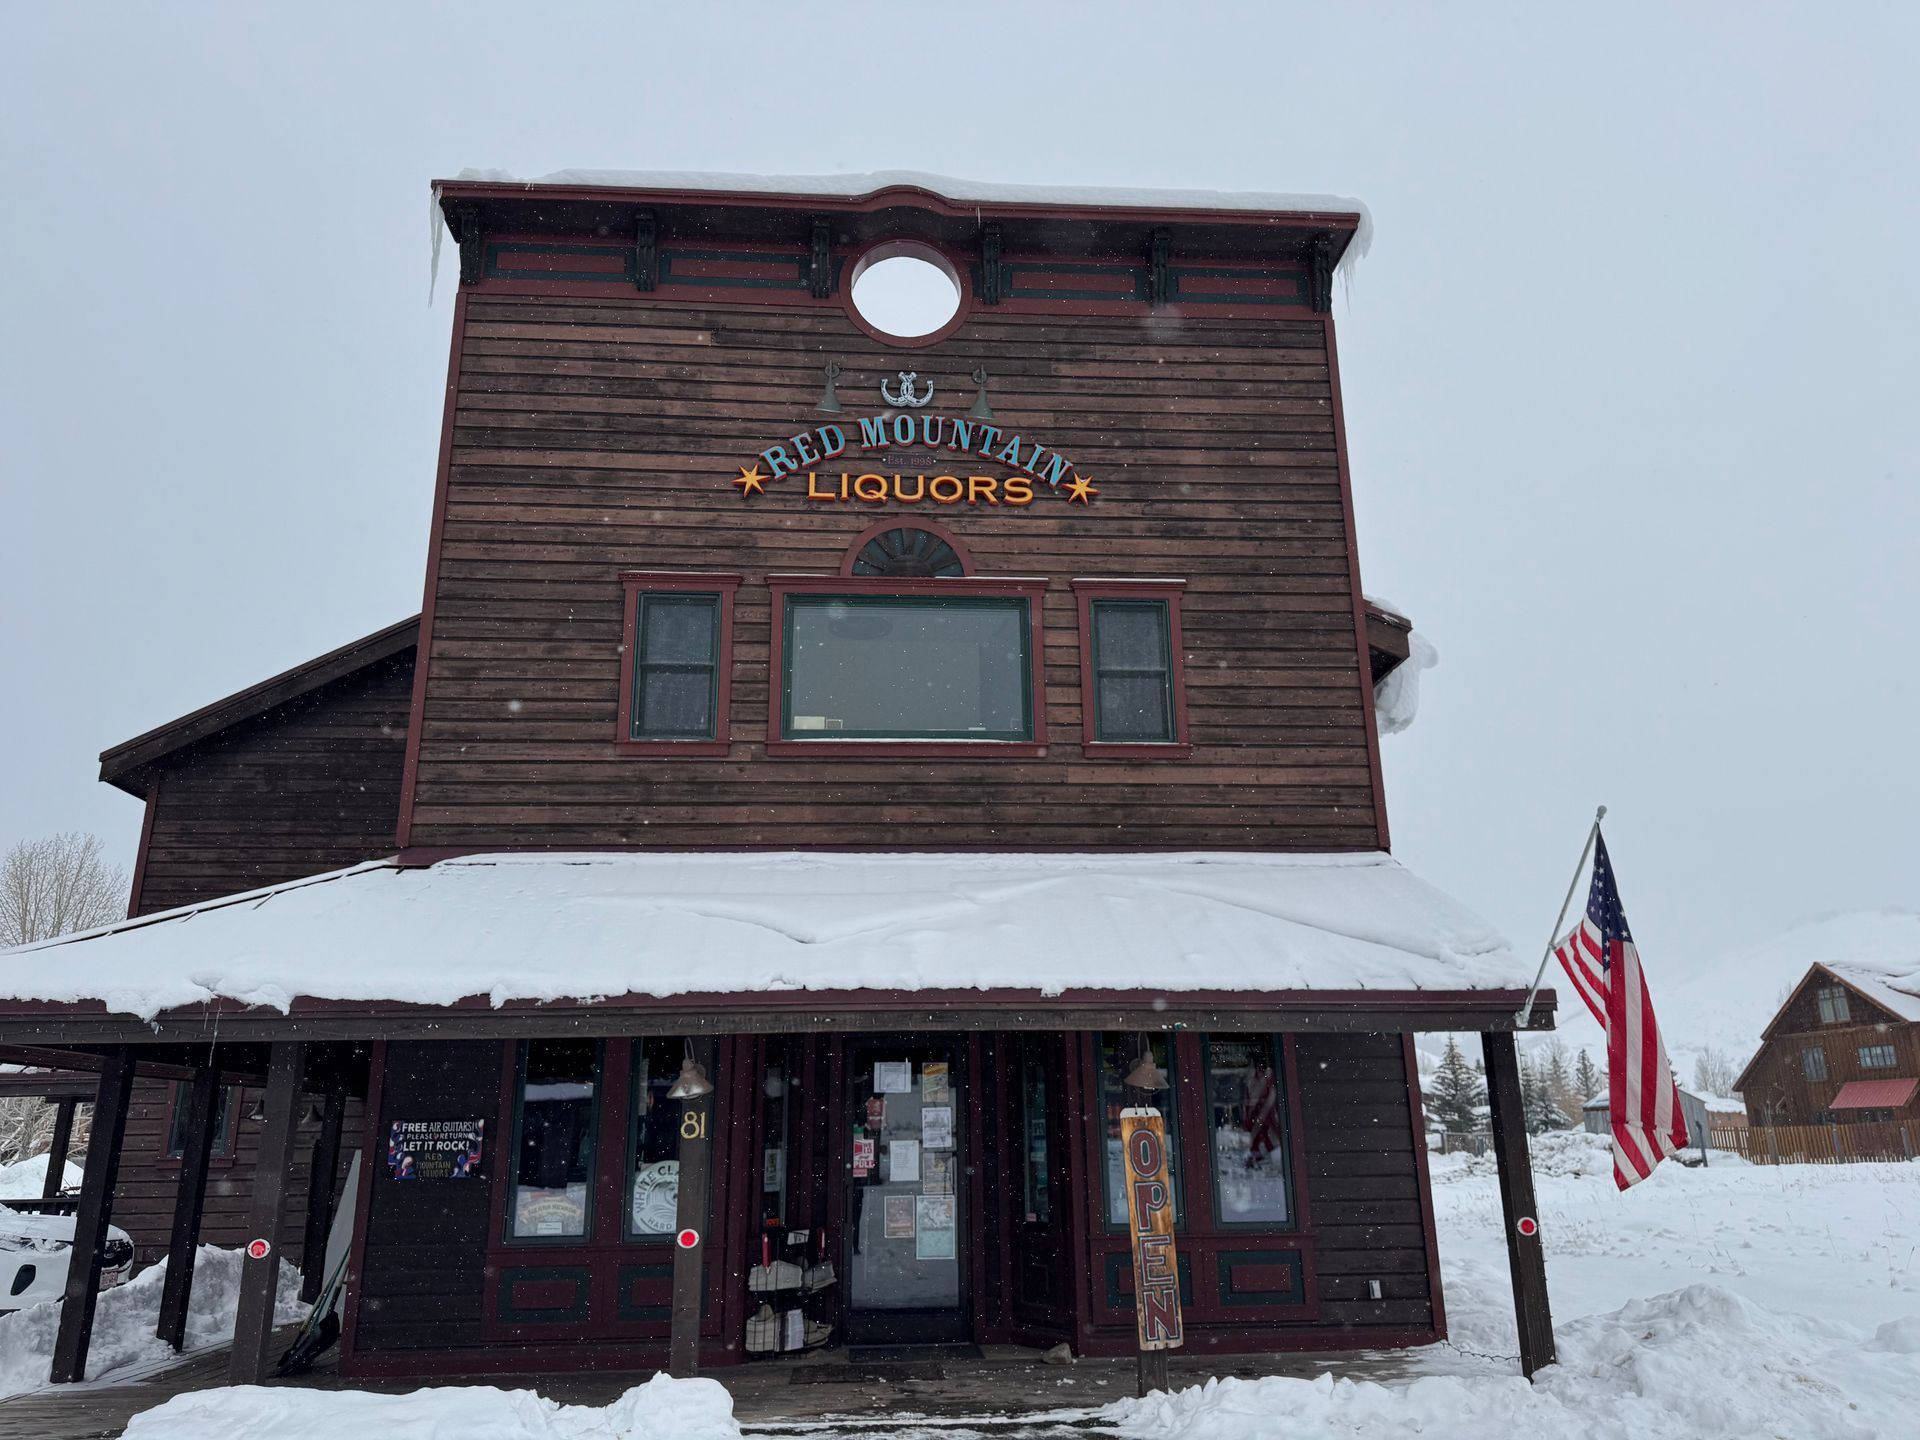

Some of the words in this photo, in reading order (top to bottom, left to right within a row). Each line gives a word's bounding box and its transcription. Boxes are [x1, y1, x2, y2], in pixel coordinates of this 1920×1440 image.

[760, 424, 846, 481] RED
[857, 414, 1074, 490] MOUNTAIN
[887, 455, 907, 465] Est.
[911, 456, 933, 466] 1998
[807, 471, 1034, 505] LIQUORS
[402, 1122, 428, 1132] FREE
[428, 1121, 442, 1132] AIR
[442, 1121, 475, 1132] GUITARS!
[680, 1111, 706, 1139] 81
[440, 1132, 468, 1140] RETURN
[403, 1141, 422, 1151] LET
[424, 1141, 434, 1151] IT
[436, 1140, 470, 1151] ROCK!
[416, 1160, 451, 1169] MOUNTAIN
[418, 1169, 449, 1178] LIQUORS
[634, 1171, 657, 1213] WHITE
[647, 1217, 672, 1230] HARD
[1129, 1128, 1181, 1342] OPEN
